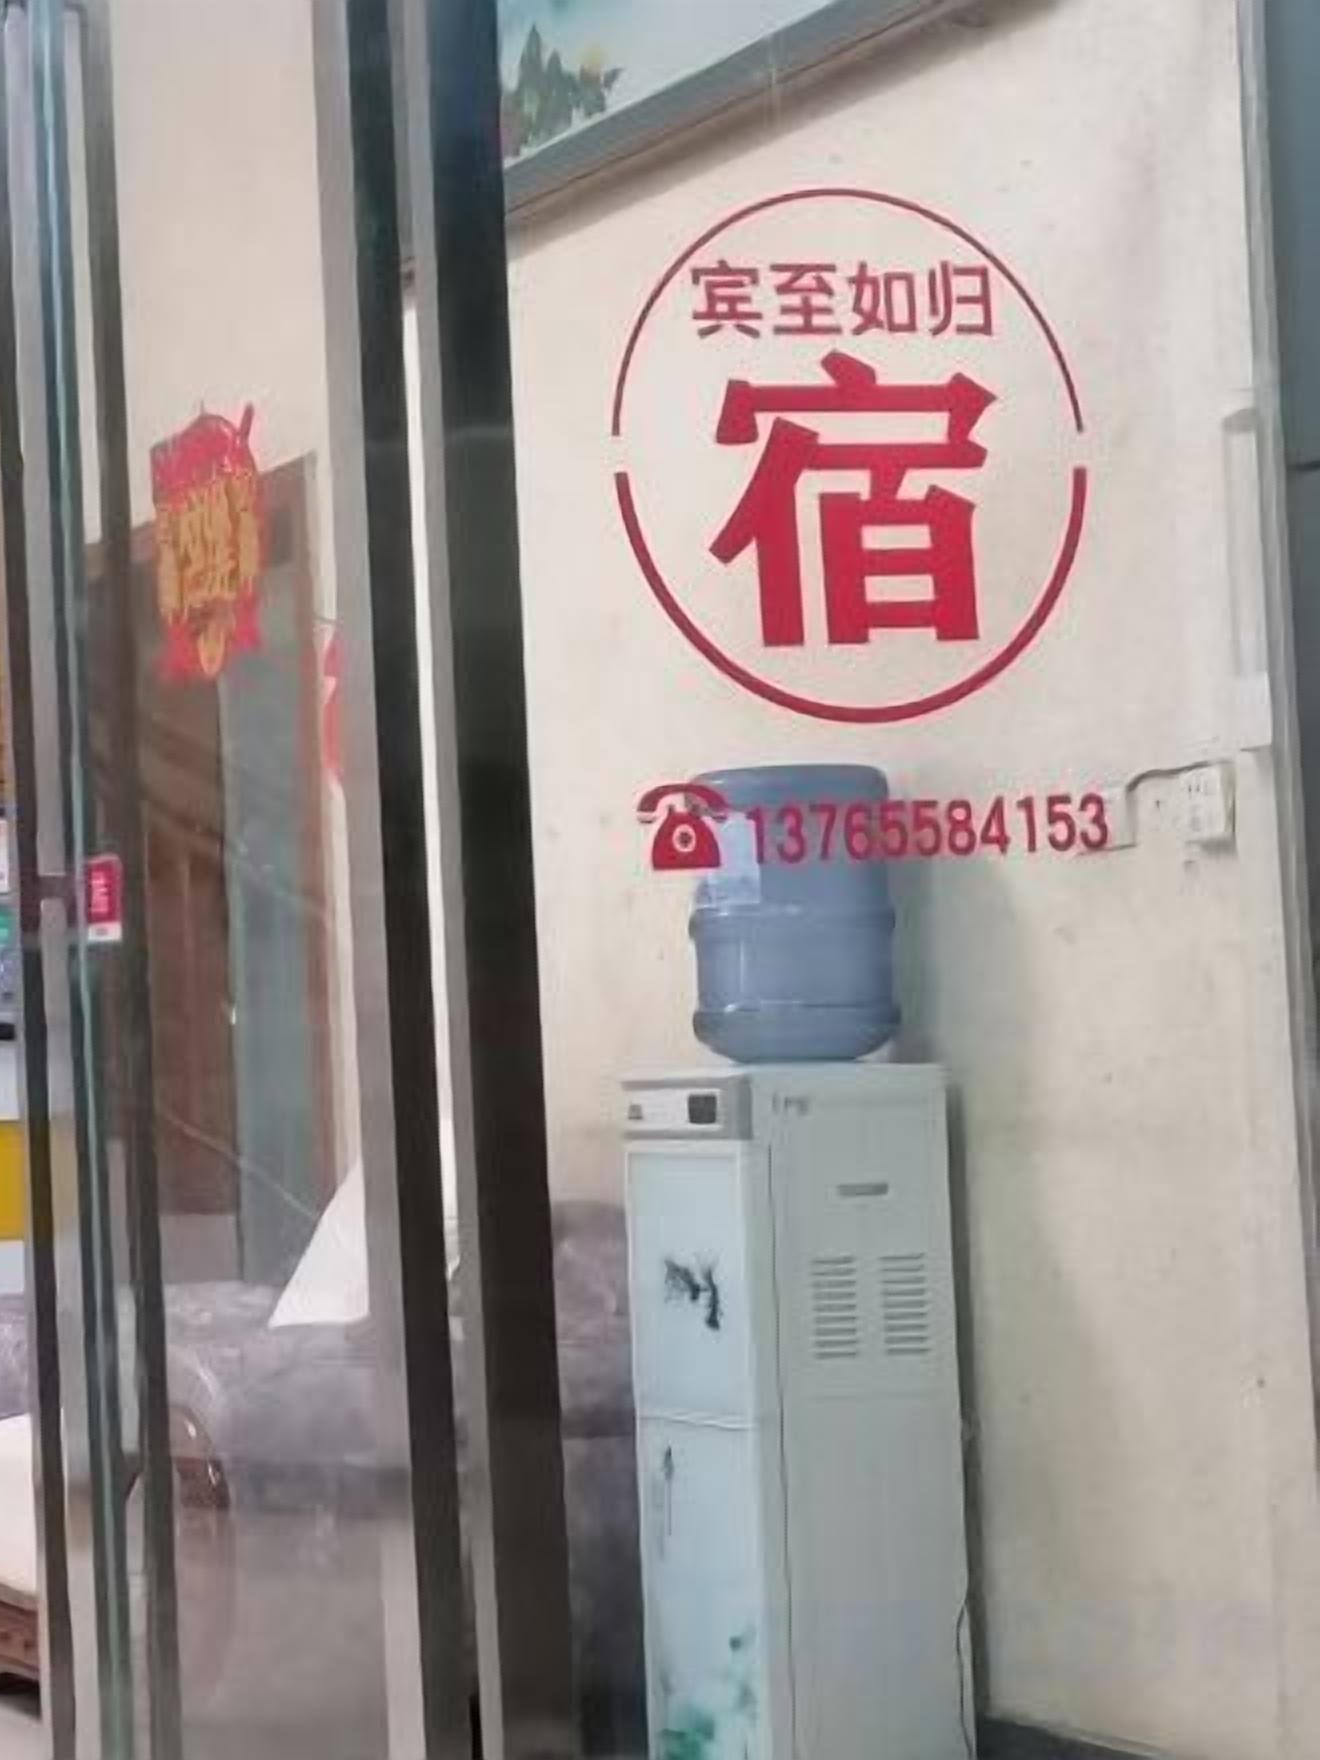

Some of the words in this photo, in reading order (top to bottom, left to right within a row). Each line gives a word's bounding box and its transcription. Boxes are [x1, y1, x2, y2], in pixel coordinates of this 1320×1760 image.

[691, 260, 994, 338] 宾至如归
[709, 350, 998, 647] 宿
[746, 793, 1110, 865] 13765584153
